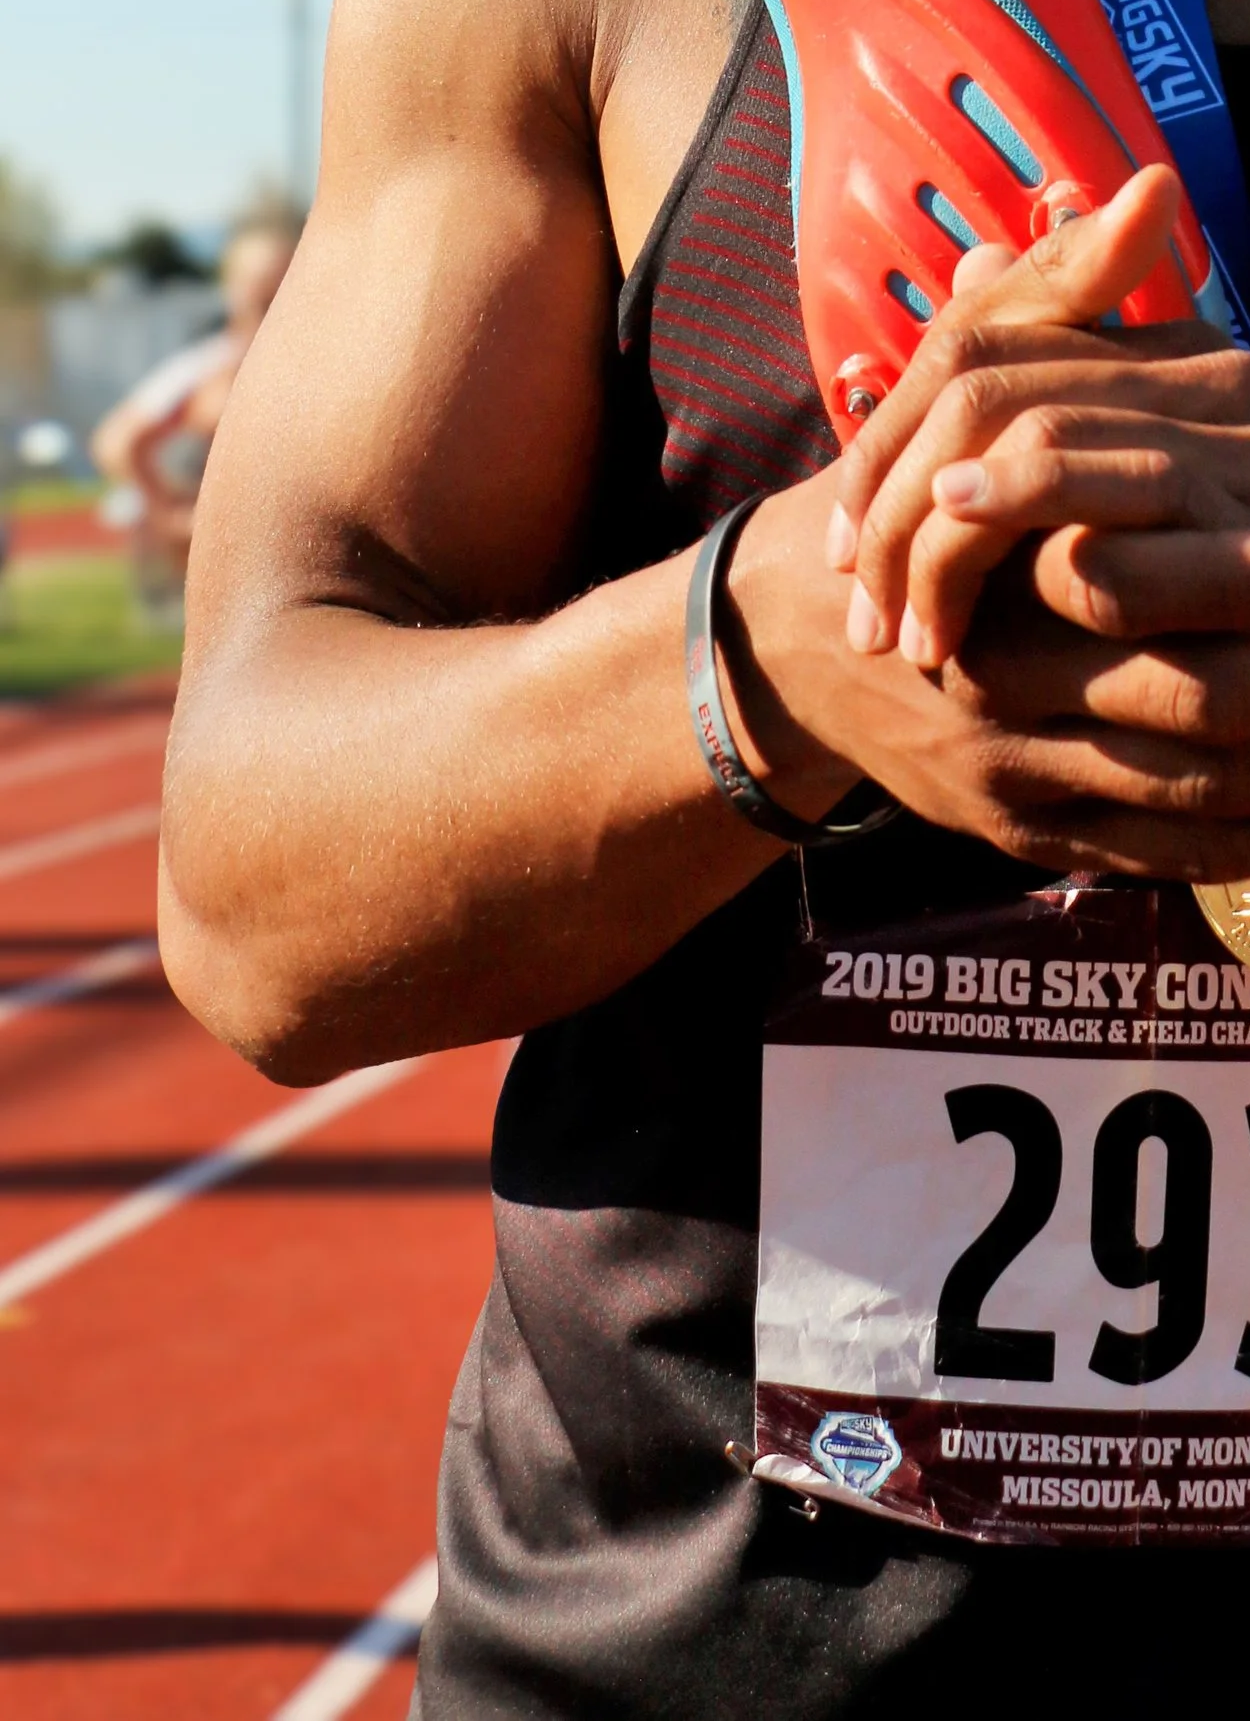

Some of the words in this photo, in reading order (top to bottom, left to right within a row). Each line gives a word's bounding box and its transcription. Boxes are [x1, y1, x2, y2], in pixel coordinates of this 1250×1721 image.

[822, 951, 934, 1000] 2019
[945, 955, 1031, 1005] BIG
[1042, 960, 1146, 1009] SKY
[890, 1010, 1010, 1039] OUTDOOR
[1015, 1015, 1103, 1043] TRACK
[1107, 1020, 1127, 1044] &
[1131, 1019, 1206, 1045] FIELD
[826, 1444, 888, 1458] CHAMPIONSHIPS
[940, 1428, 1140, 1466] UNIVERSITY
[1141, 1436, 1182, 1466] OF
[1002, 1476, 1171, 1510] MISSOULA,
